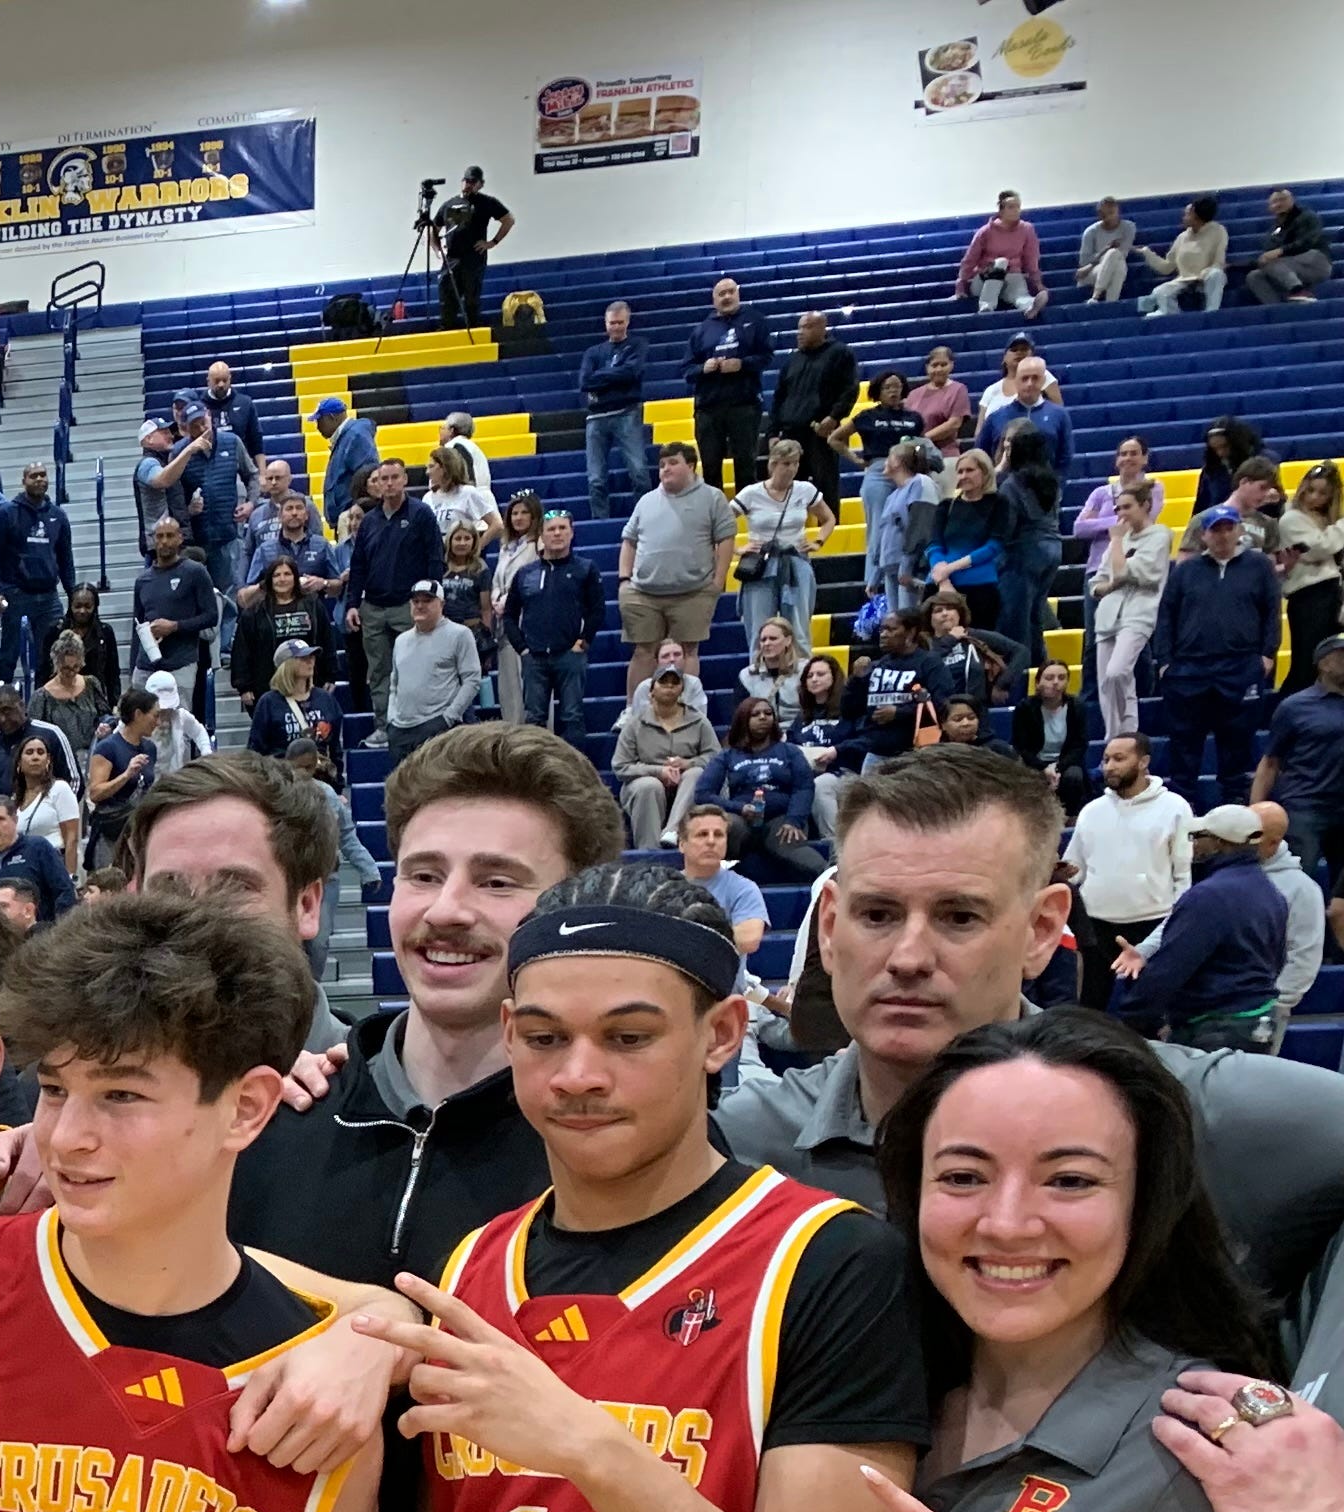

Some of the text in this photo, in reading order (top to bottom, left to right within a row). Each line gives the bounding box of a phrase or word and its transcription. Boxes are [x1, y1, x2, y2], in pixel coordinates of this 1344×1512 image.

[596, 79, 694, 99] FRANKLIN ATHLETICS
[58, 123, 154, 145] DETERMINATION
[85, 173, 250, 214] WARRIORS
[68, 216, 103, 235] THE
[108, 206, 203, 230] DYNASTY
[869, 667, 917, 693] SHP
